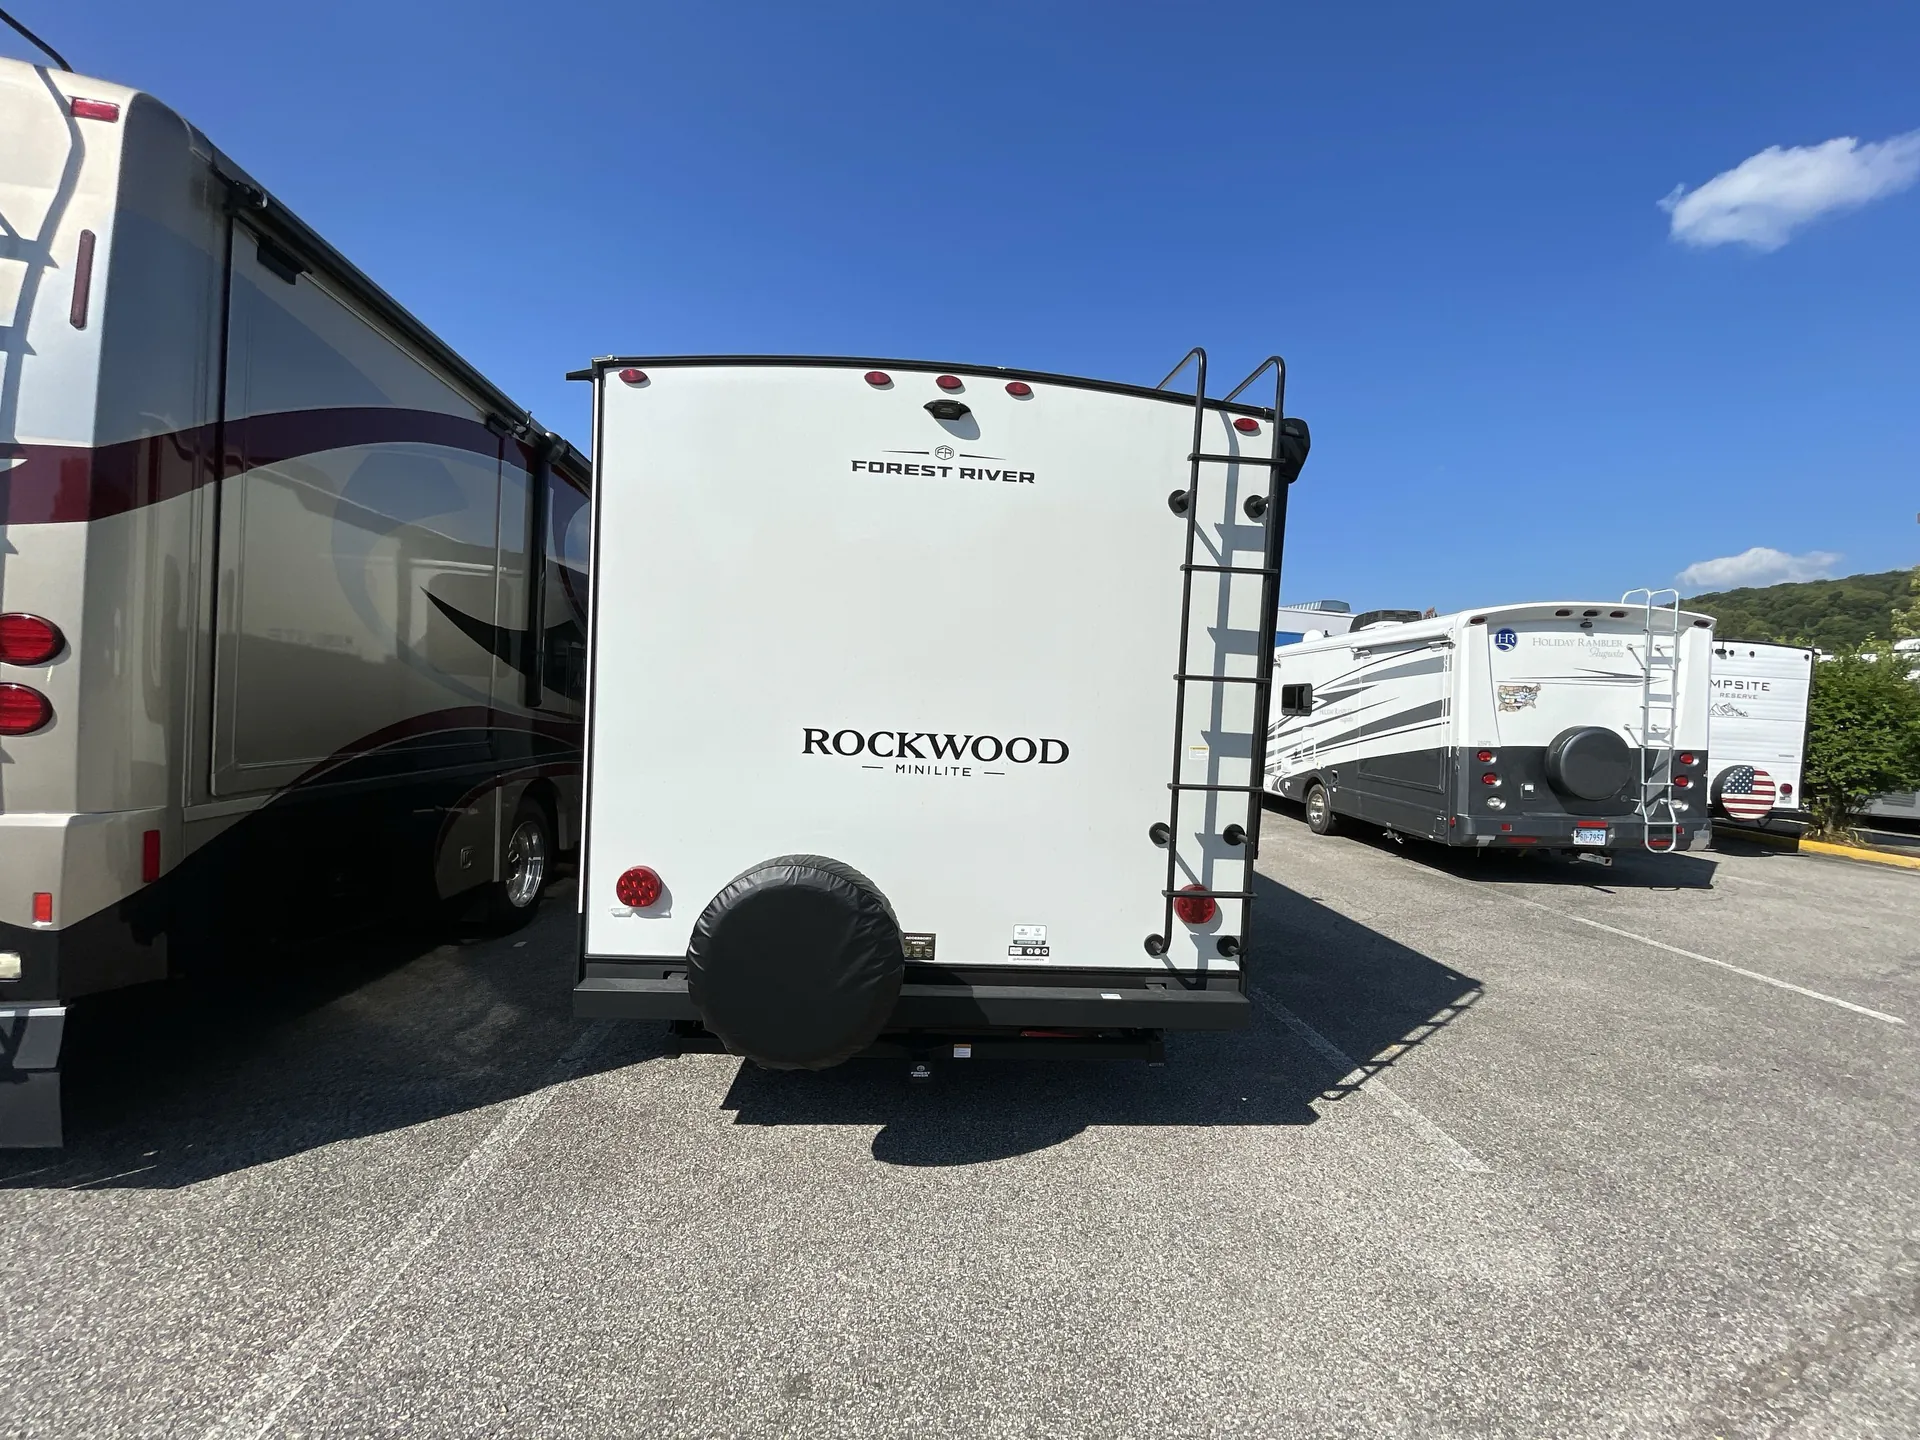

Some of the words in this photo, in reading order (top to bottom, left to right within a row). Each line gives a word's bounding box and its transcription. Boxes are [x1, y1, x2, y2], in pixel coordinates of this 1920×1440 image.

[851, 460, 953, 478] FOREST
[959, 467, 1035, 484] RIVER
[1498, 633, 1515, 644] HR
[1532, 637, 1576, 647] HOLIDAY
[1577, 637, 1623, 647] RAMBLER
[1588, 647, 1624, 659] Augusta
[1719, 692, 1758, 700] RESERVE
[801, 727, 1070, 765] ROCKWOOD
[895, 763, 972, 777] MINILITE
